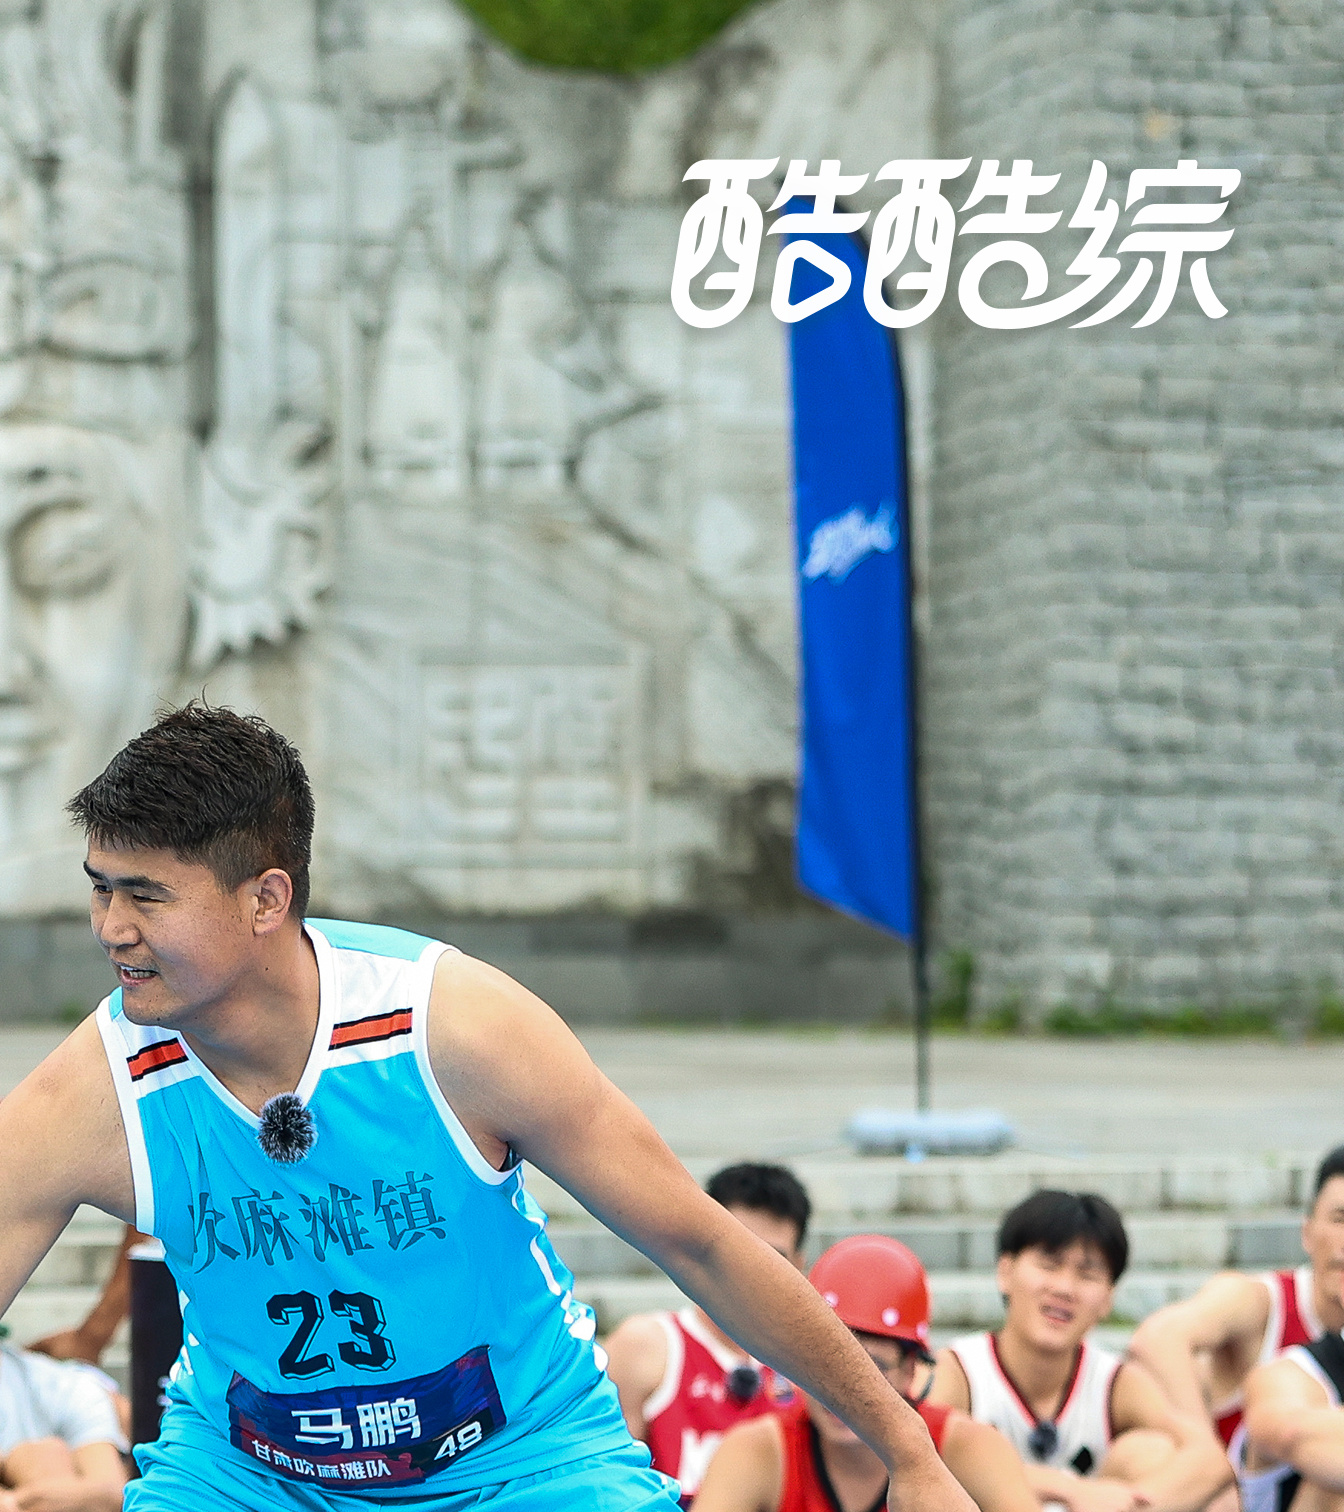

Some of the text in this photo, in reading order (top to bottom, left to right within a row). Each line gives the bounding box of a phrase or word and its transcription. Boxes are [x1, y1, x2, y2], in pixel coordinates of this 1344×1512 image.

[265, 1288, 397, 1381] 23
[251, 1420, 484, 1481] 甘肃吹麻滩队 48
[290, 1397, 422, 1450] 马鹏
